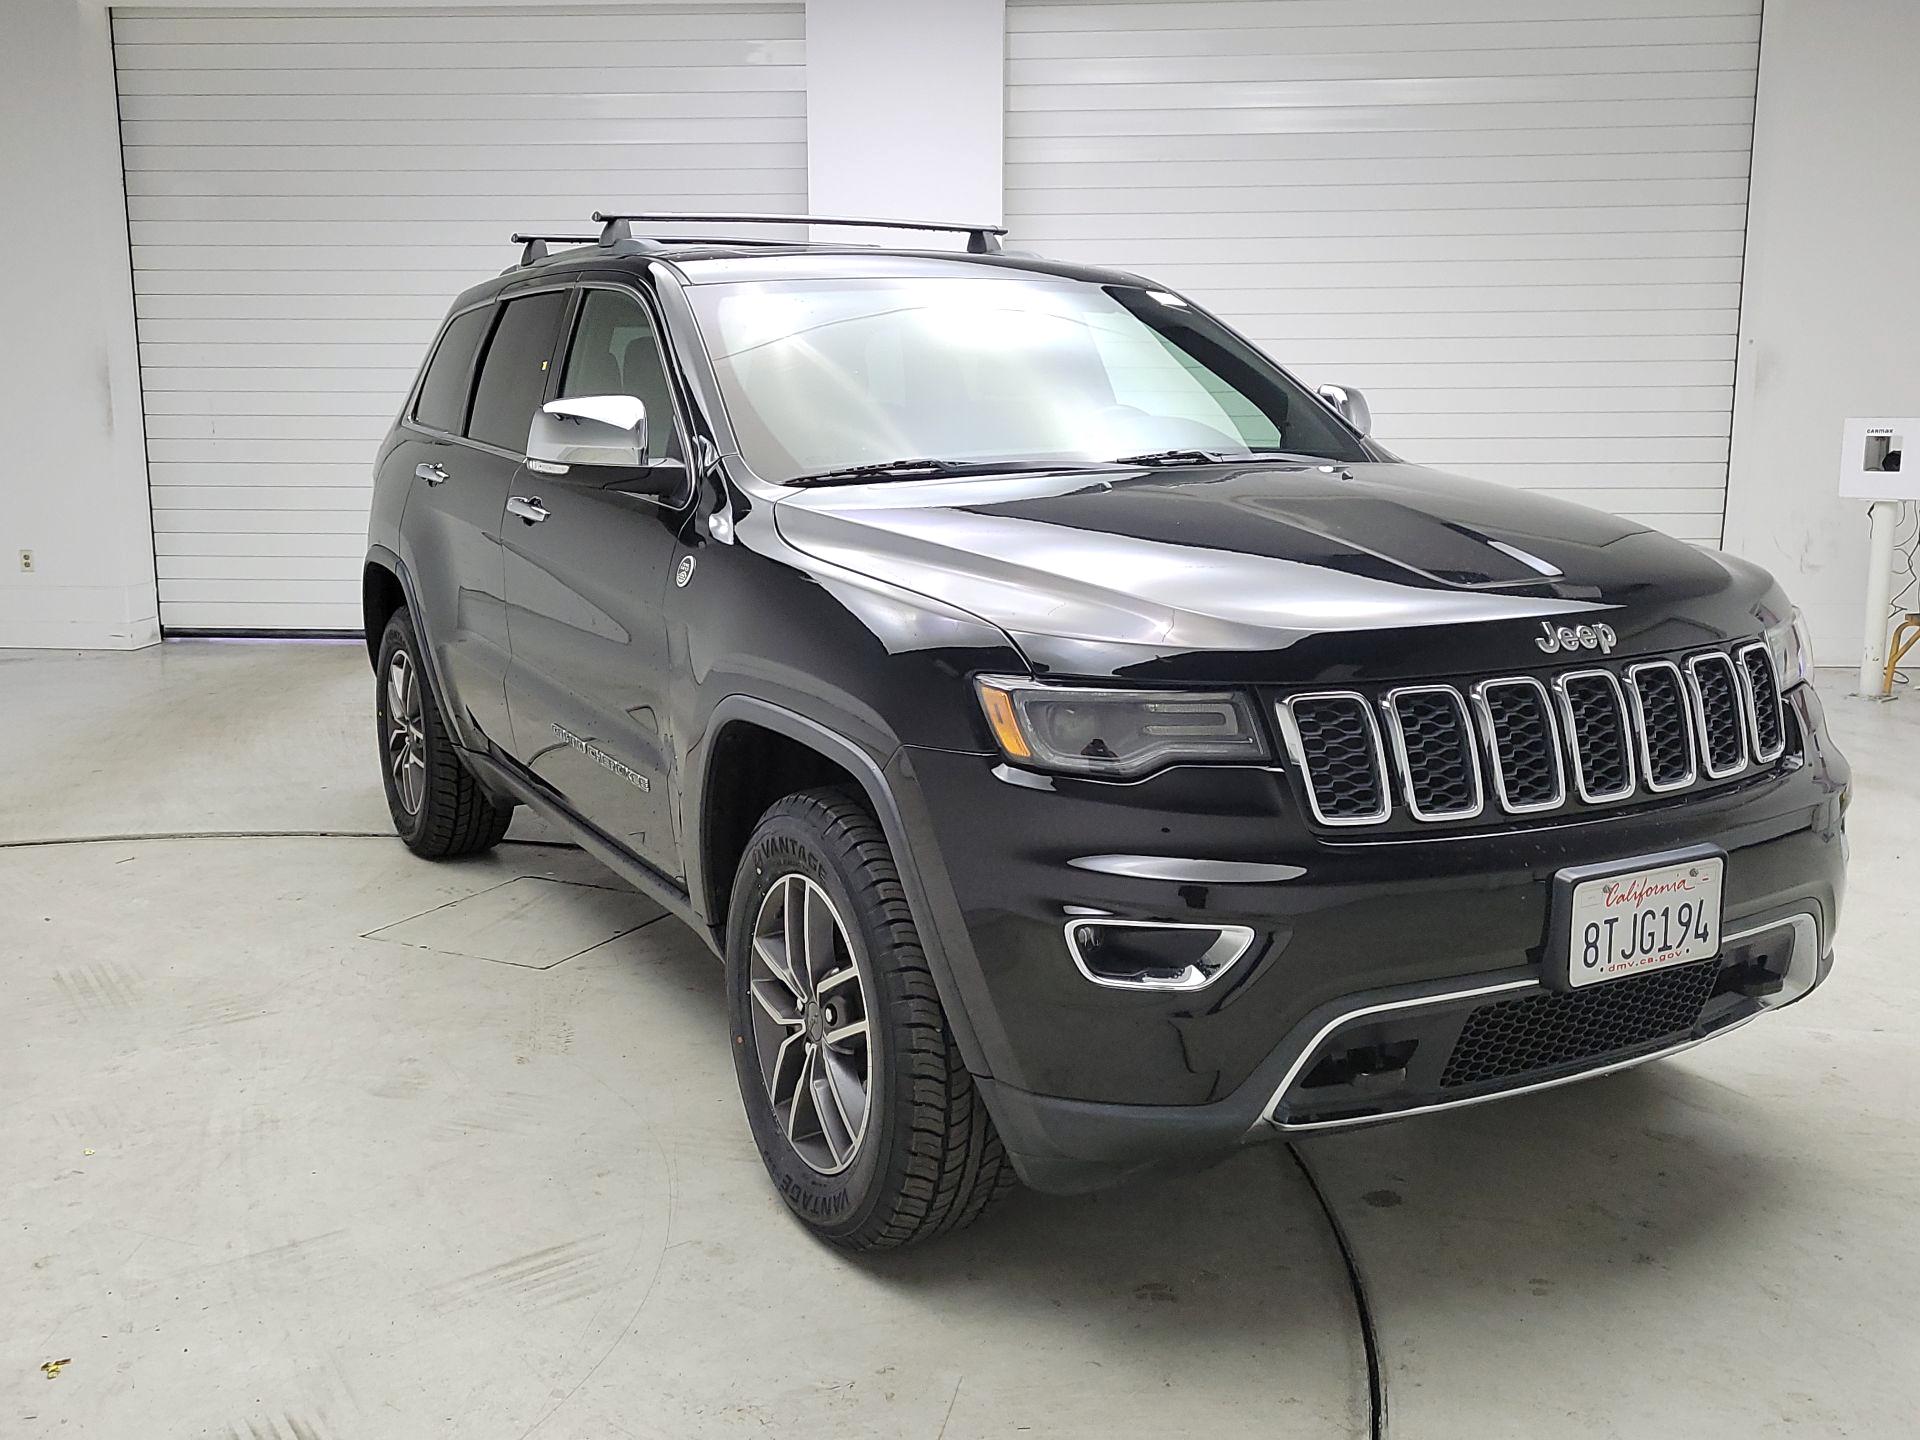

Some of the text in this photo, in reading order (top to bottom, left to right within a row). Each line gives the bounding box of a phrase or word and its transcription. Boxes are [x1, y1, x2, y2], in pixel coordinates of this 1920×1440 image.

[1535, 621, 1618, 654] Jeep
[761, 835, 828, 881] VANTAGE
[1605, 873, 1696, 909] California
[1583, 898, 1709, 969] 8TJG194
[1608, 950, 1683, 973] dmv.ca.gov
[778, 1173, 850, 1216] VANTAGE
